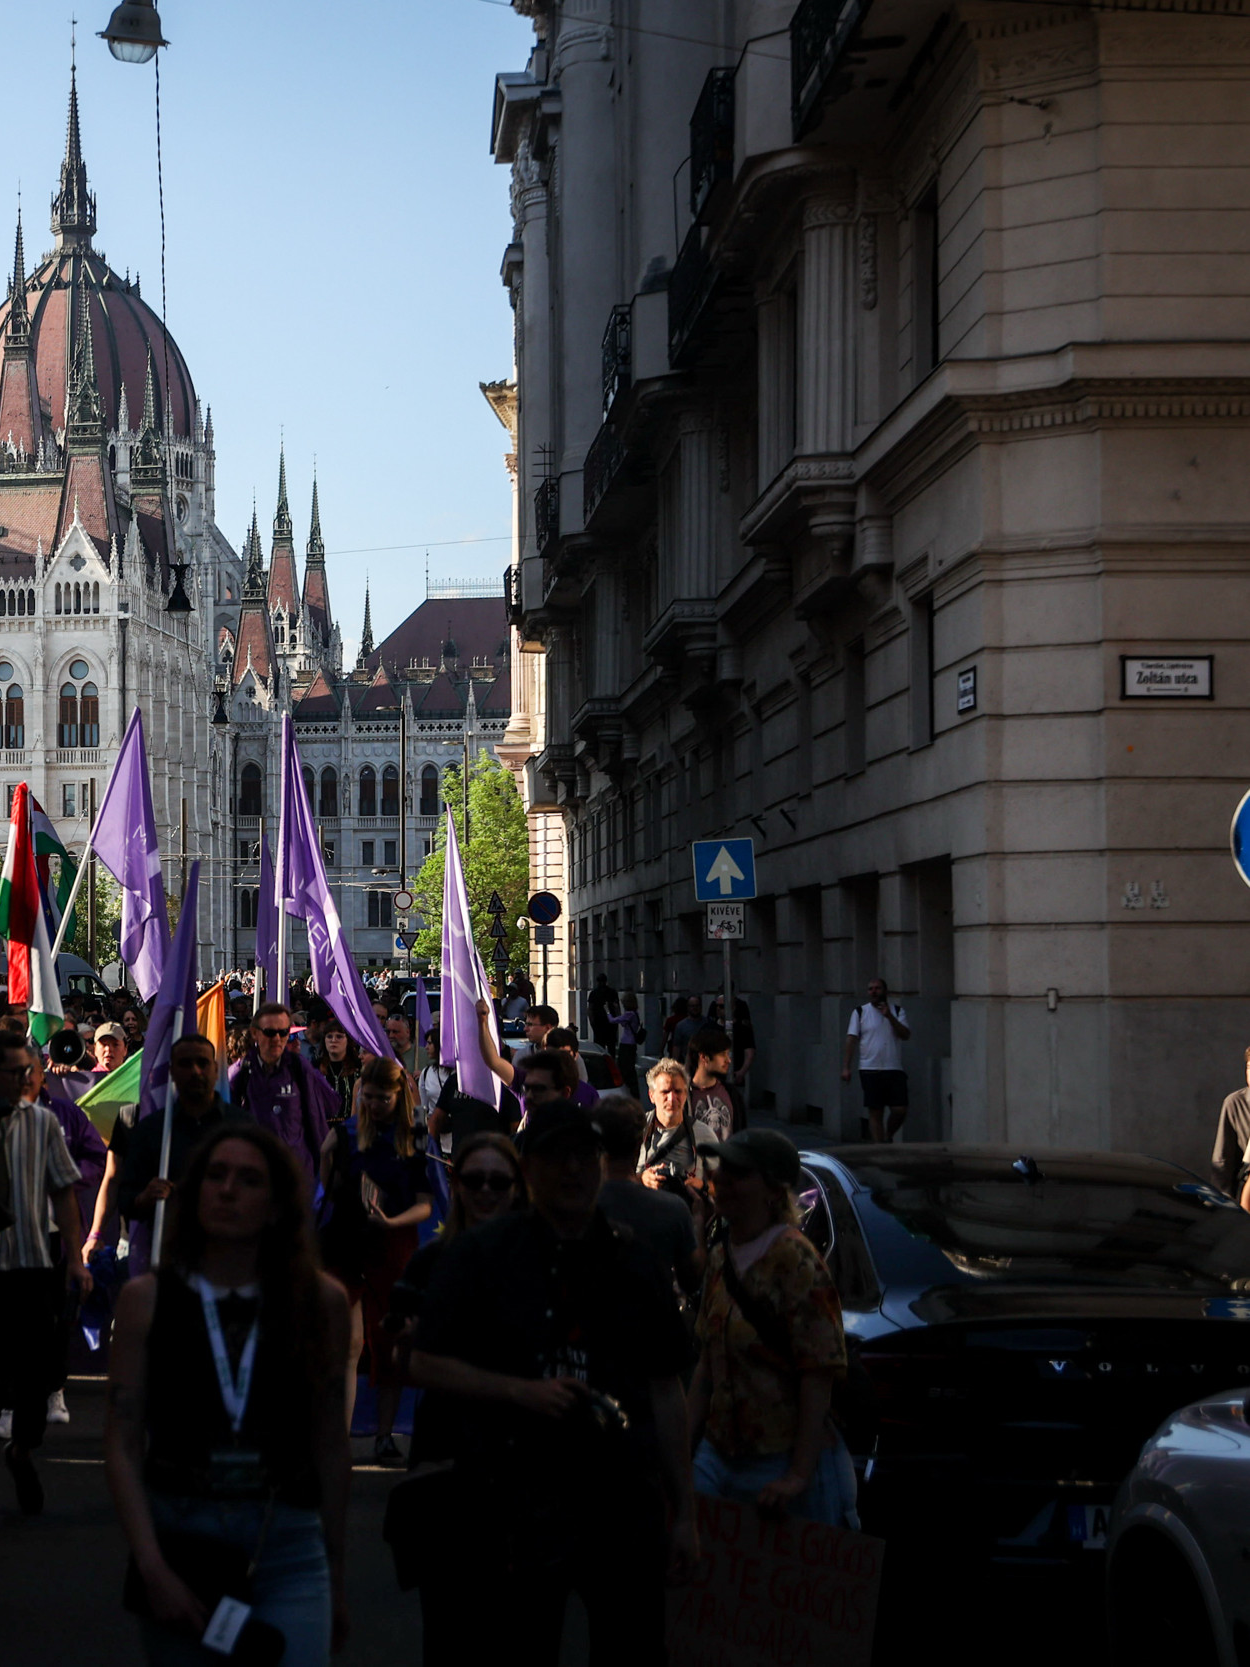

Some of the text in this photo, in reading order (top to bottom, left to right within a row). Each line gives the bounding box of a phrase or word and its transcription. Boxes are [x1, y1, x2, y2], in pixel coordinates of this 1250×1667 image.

[1136, 670, 1198, 684] Zoltán utca
[710, 905, 740, 915] KIVÉVE
[1048, 1359, 1250, 1375] VOLVO
